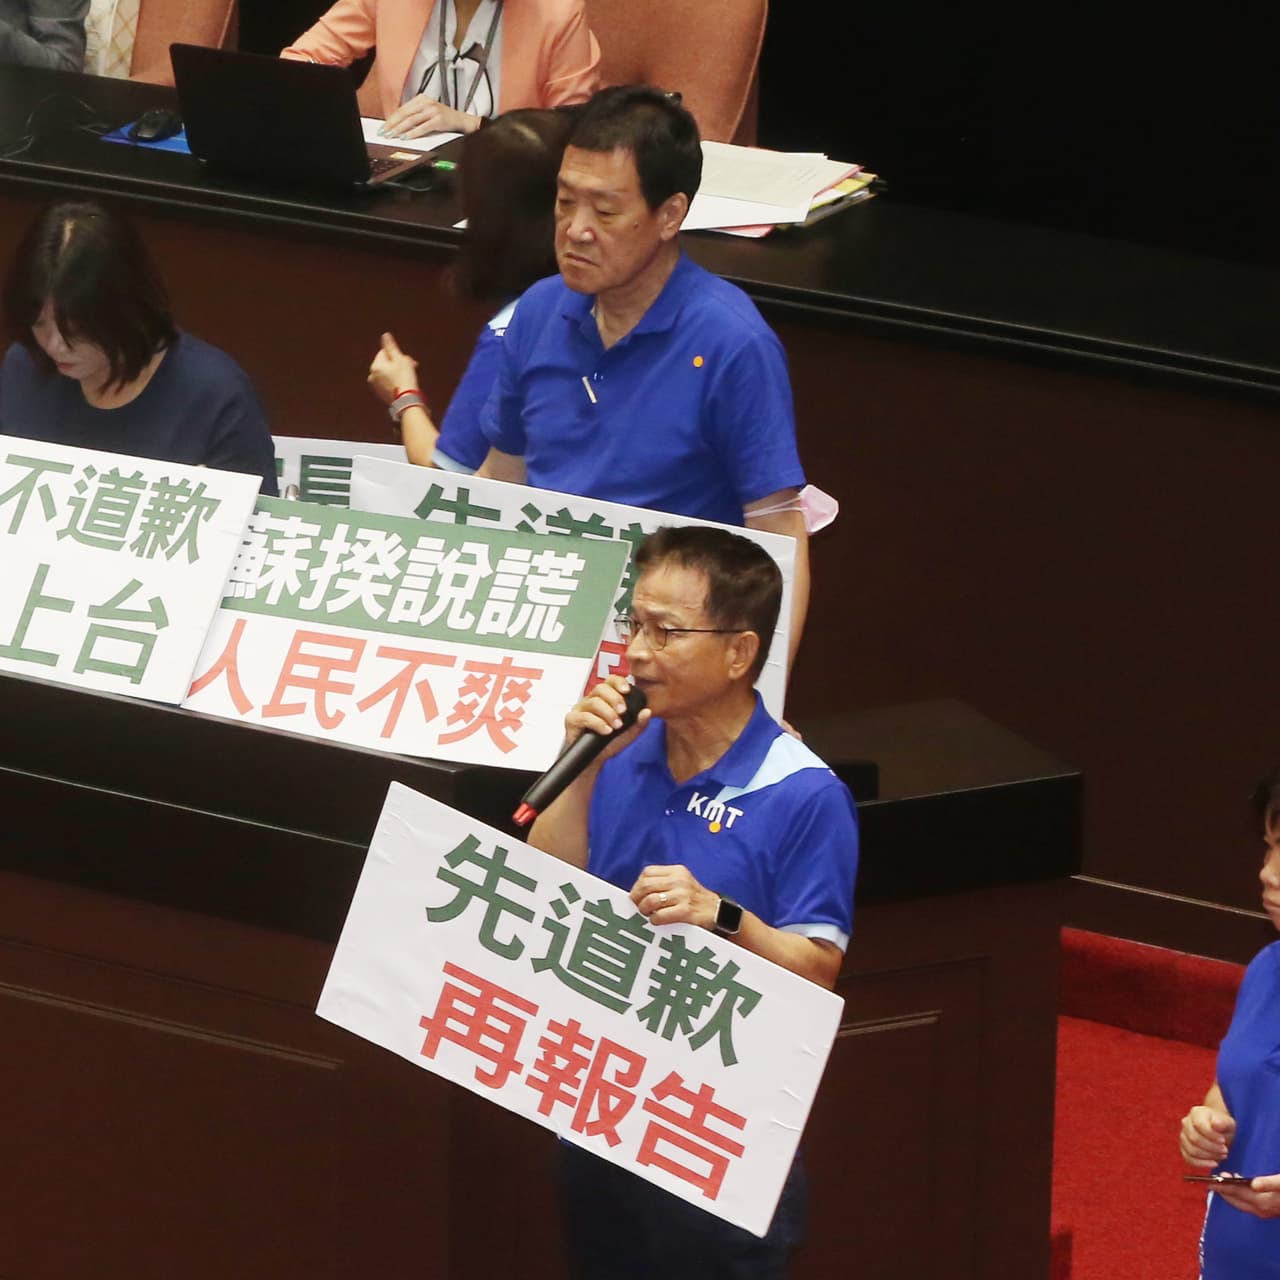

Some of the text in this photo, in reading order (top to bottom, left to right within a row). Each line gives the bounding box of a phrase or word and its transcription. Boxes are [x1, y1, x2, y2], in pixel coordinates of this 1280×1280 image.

[223, 510, 587, 643] 蘇揆說謊
[188, 618, 545, 755] 人民不爽
[686, 791, 744, 829] KMT
[425, 833, 763, 1068] 先道歉
[418, 961, 748, 1201] 再報告
